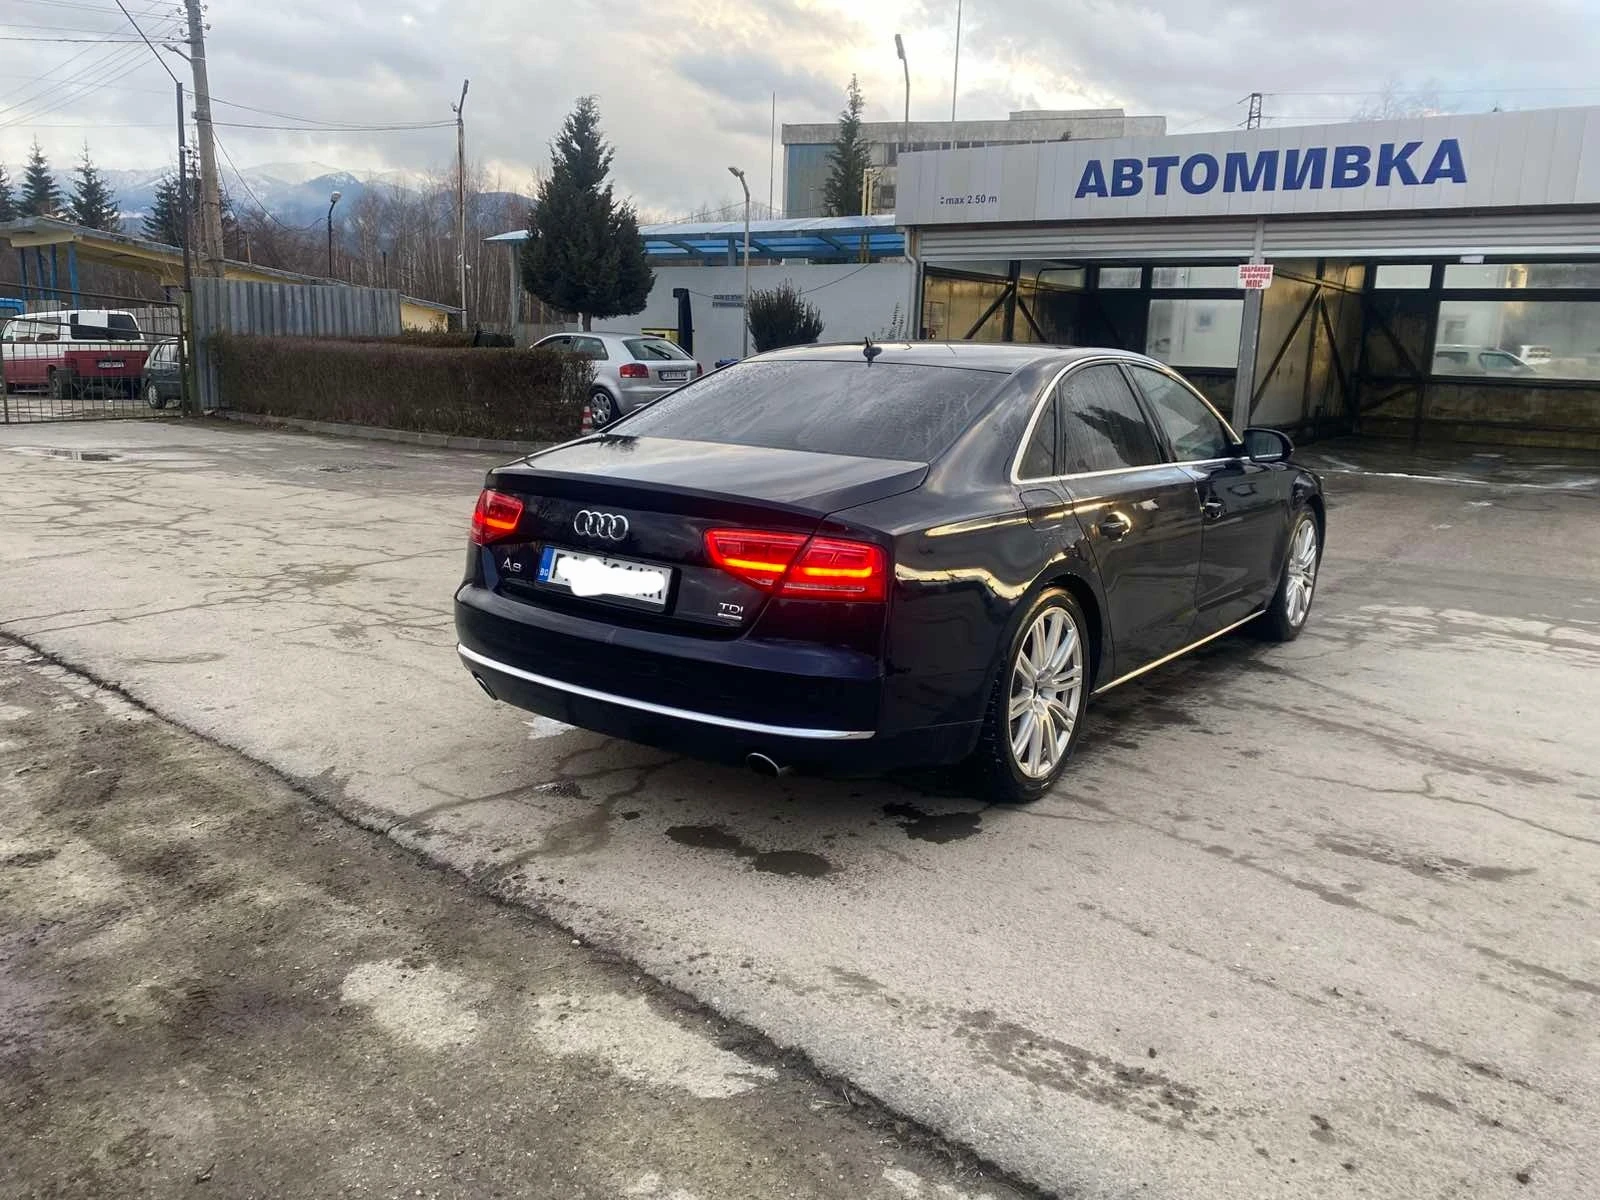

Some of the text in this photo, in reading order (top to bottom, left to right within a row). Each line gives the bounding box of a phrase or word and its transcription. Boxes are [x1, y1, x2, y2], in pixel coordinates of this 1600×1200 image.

[1075, 138, 1468, 198] АВТОМИВКА
[945, 197, 965, 205] max
[989, 195, 997, 203] m
[501, 556, 522, 573] A8
[719, 602, 744, 615] TDI
